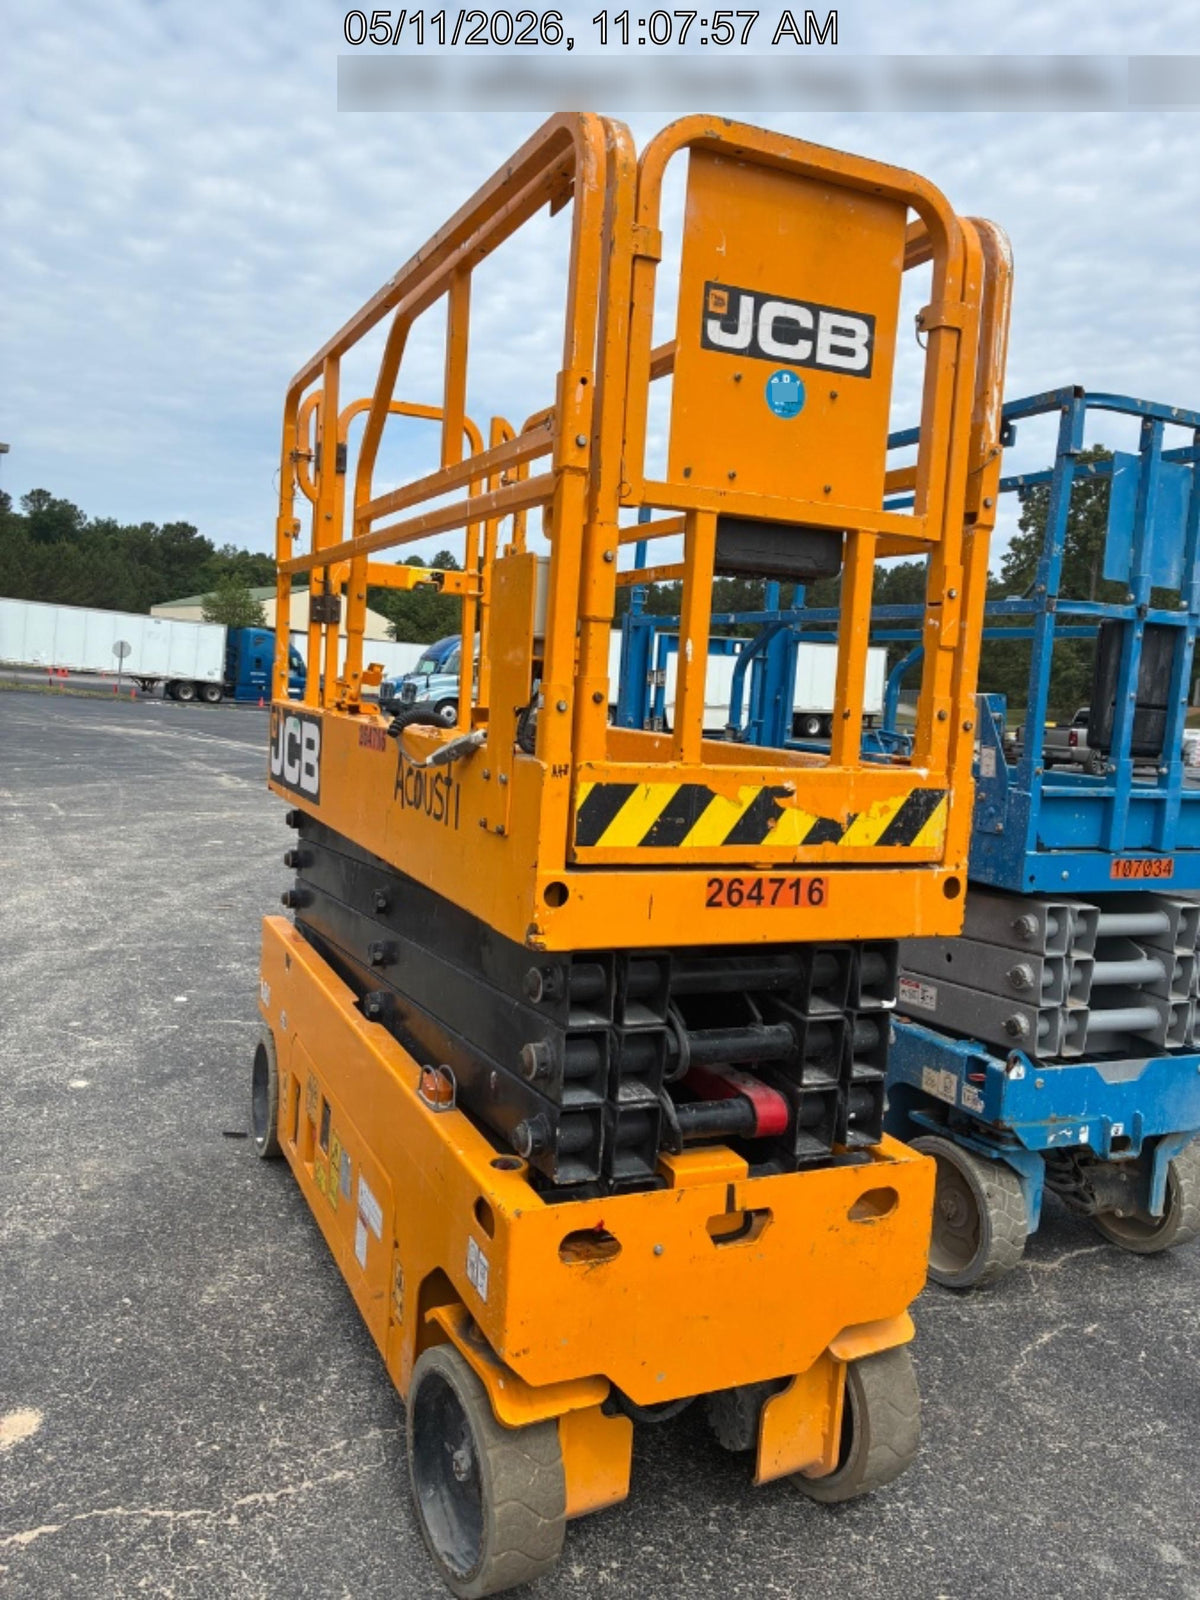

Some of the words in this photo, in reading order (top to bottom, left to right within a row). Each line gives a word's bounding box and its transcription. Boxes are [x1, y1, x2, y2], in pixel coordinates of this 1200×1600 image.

[706, 294, 870, 371] JCB
[271, 709, 320, 796] JCB
[705, 877, 825, 908] 264716
[1112, 859, 1173, 878] 107034
